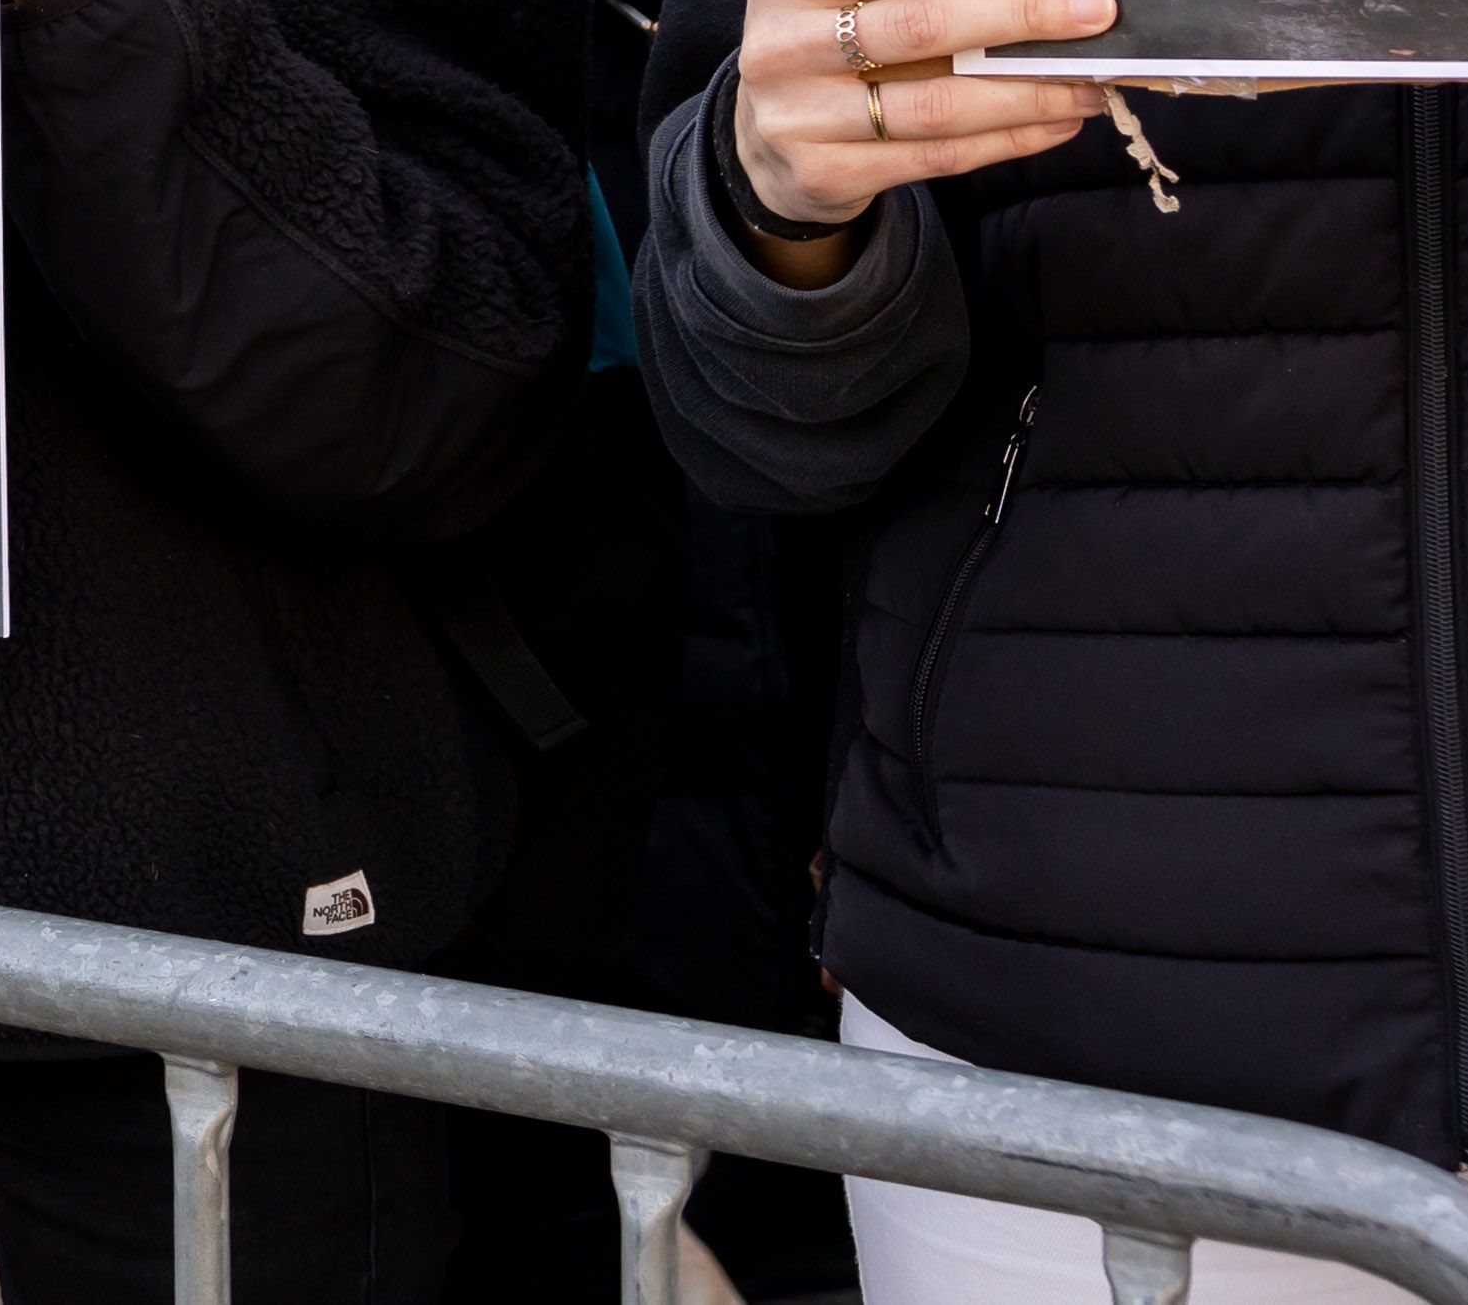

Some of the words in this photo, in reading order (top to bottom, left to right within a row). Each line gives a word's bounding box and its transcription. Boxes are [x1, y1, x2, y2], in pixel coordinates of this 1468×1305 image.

[331, 890, 352, 904] THE
[313, 899, 352, 918] NORTH
[326, 909, 352, 925] FACE
